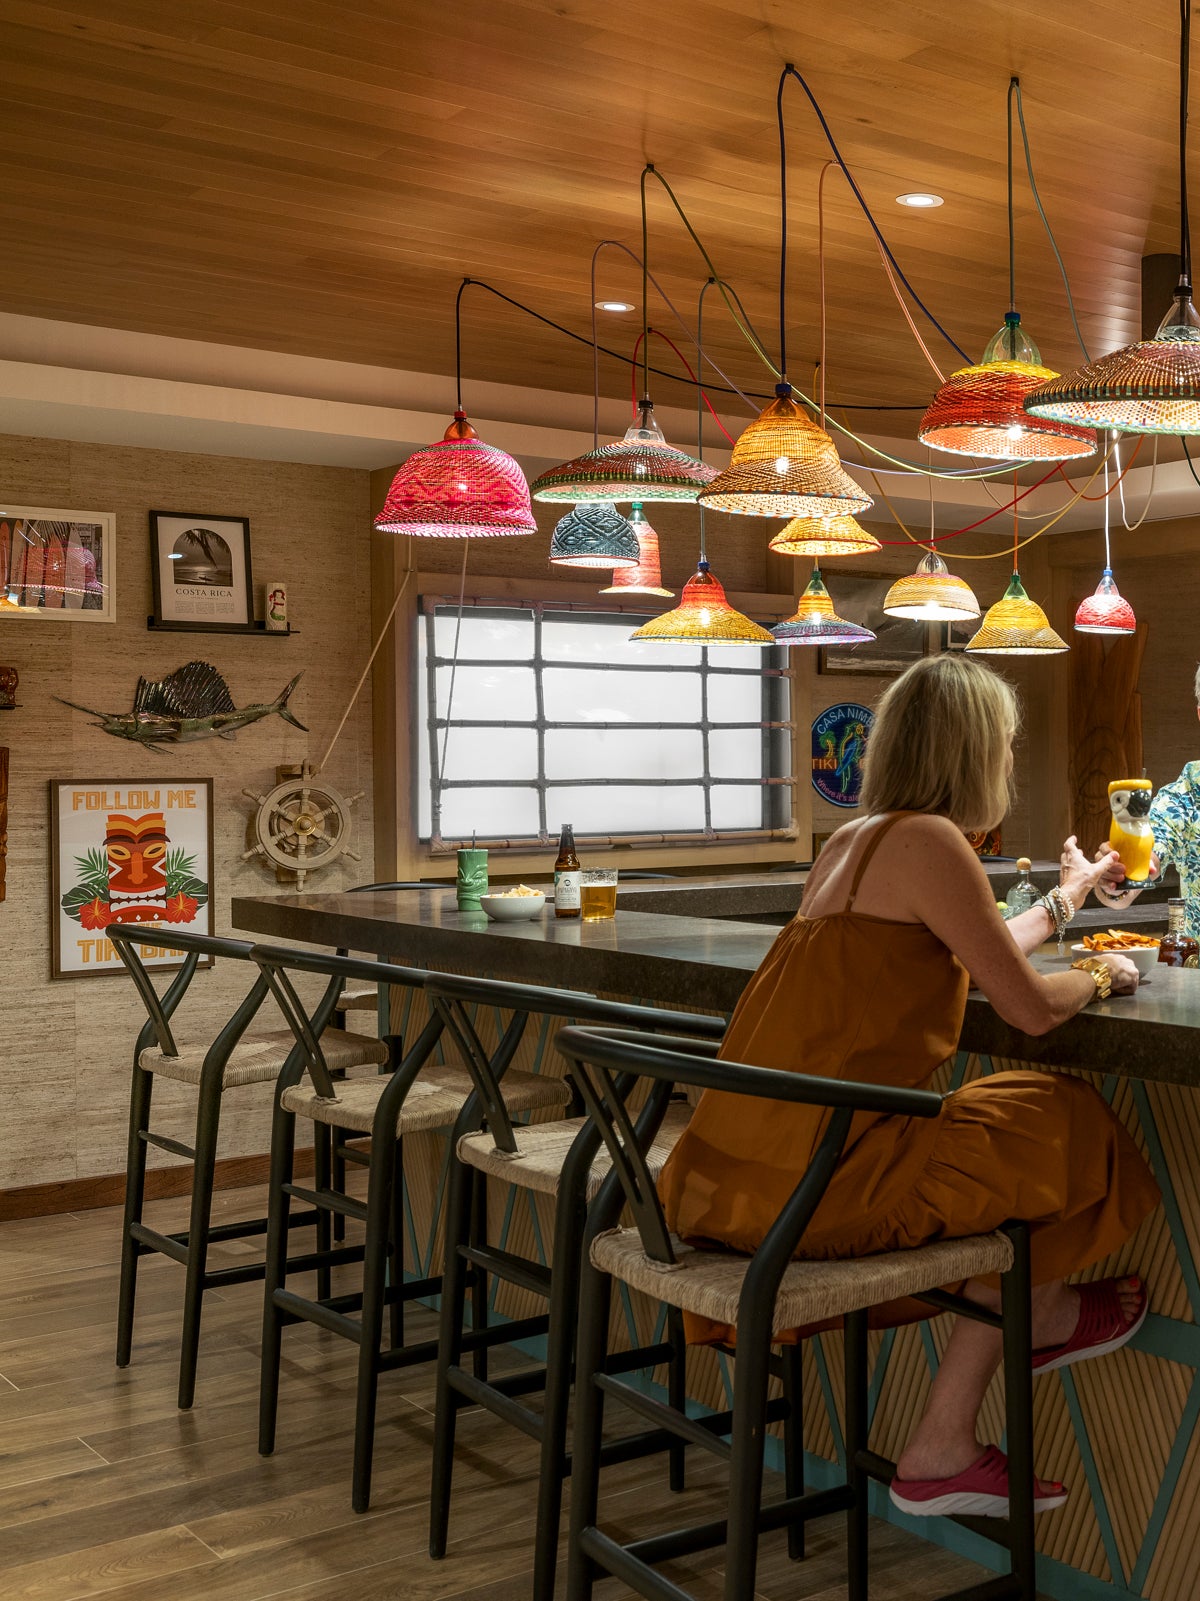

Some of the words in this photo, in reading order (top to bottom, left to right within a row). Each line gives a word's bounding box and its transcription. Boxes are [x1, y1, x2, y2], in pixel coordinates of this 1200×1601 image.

[175, 588, 207, 596] COSTA
[817, 709, 846, 734] CASA
[812, 758, 837, 770] TIKI
[72, 790, 160, 811] FOLLOW
[167, 789, 197, 809] ME
[77, 938, 122, 963] TIK
